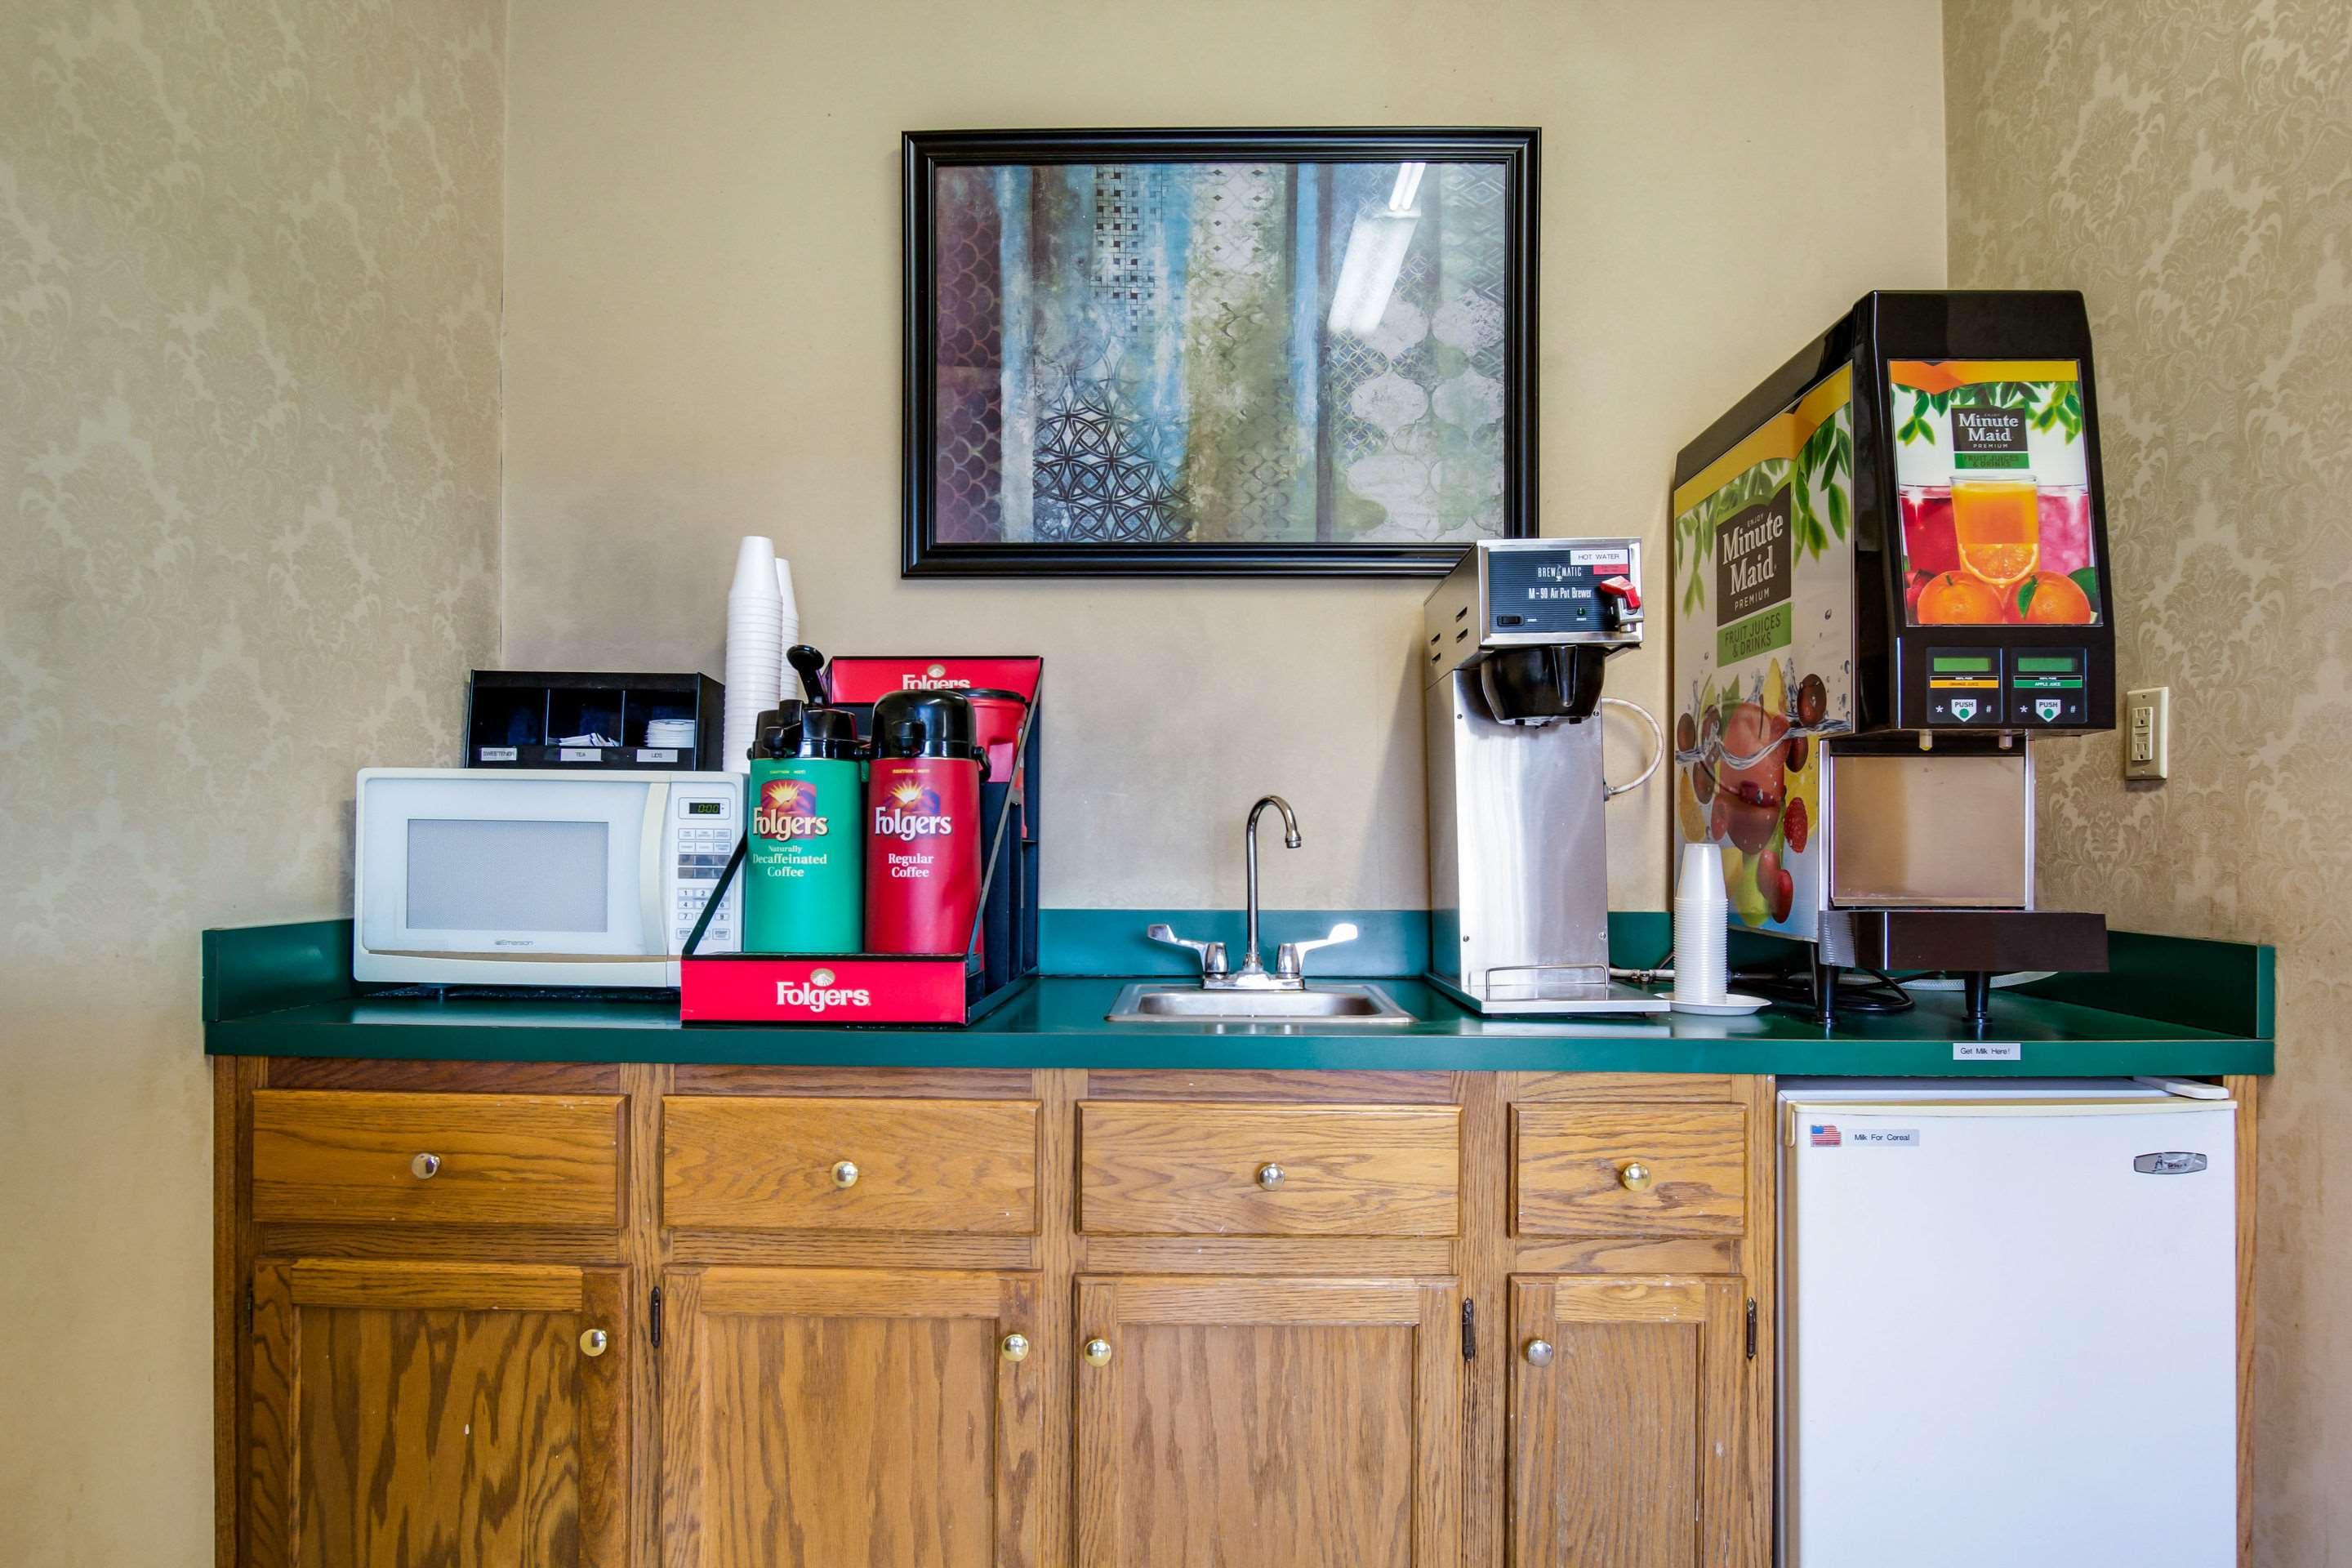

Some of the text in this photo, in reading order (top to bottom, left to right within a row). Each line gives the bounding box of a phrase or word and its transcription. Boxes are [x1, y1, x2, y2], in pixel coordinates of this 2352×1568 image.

[1958, 412, 2019, 427] Minute
[1967, 427, 2012, 442] Maid
[1747, 512, 1764, 527] ENJOY
[1722, 511, 1784, 565] Minute
[1730, 546, 1775, 595] Maid
[1550, 586, 1559, 599] Air
[1561, 586, 1570, 598] Pot
[1571, 586, 1592, 599] Brewer
[1734, 587, 1771, 612] PREMIUM
[1725, 612, 1781, 646] FRUIT JUICES
[1740, 632, 1771, 656] DRINKS
[752, 806, 829, 840] Folgers
[875, 806, 952, 841] Folgers
[768, 844, 802, 854] Naturally
[752, 853, 827, 865] Decaffeinated
[888, 853, 933, 866] Regular
[767, 866, 804, 877] Coffee
[891, 866, 929, 878] Coffee
[776, 982, 870, 1012] Folgers
